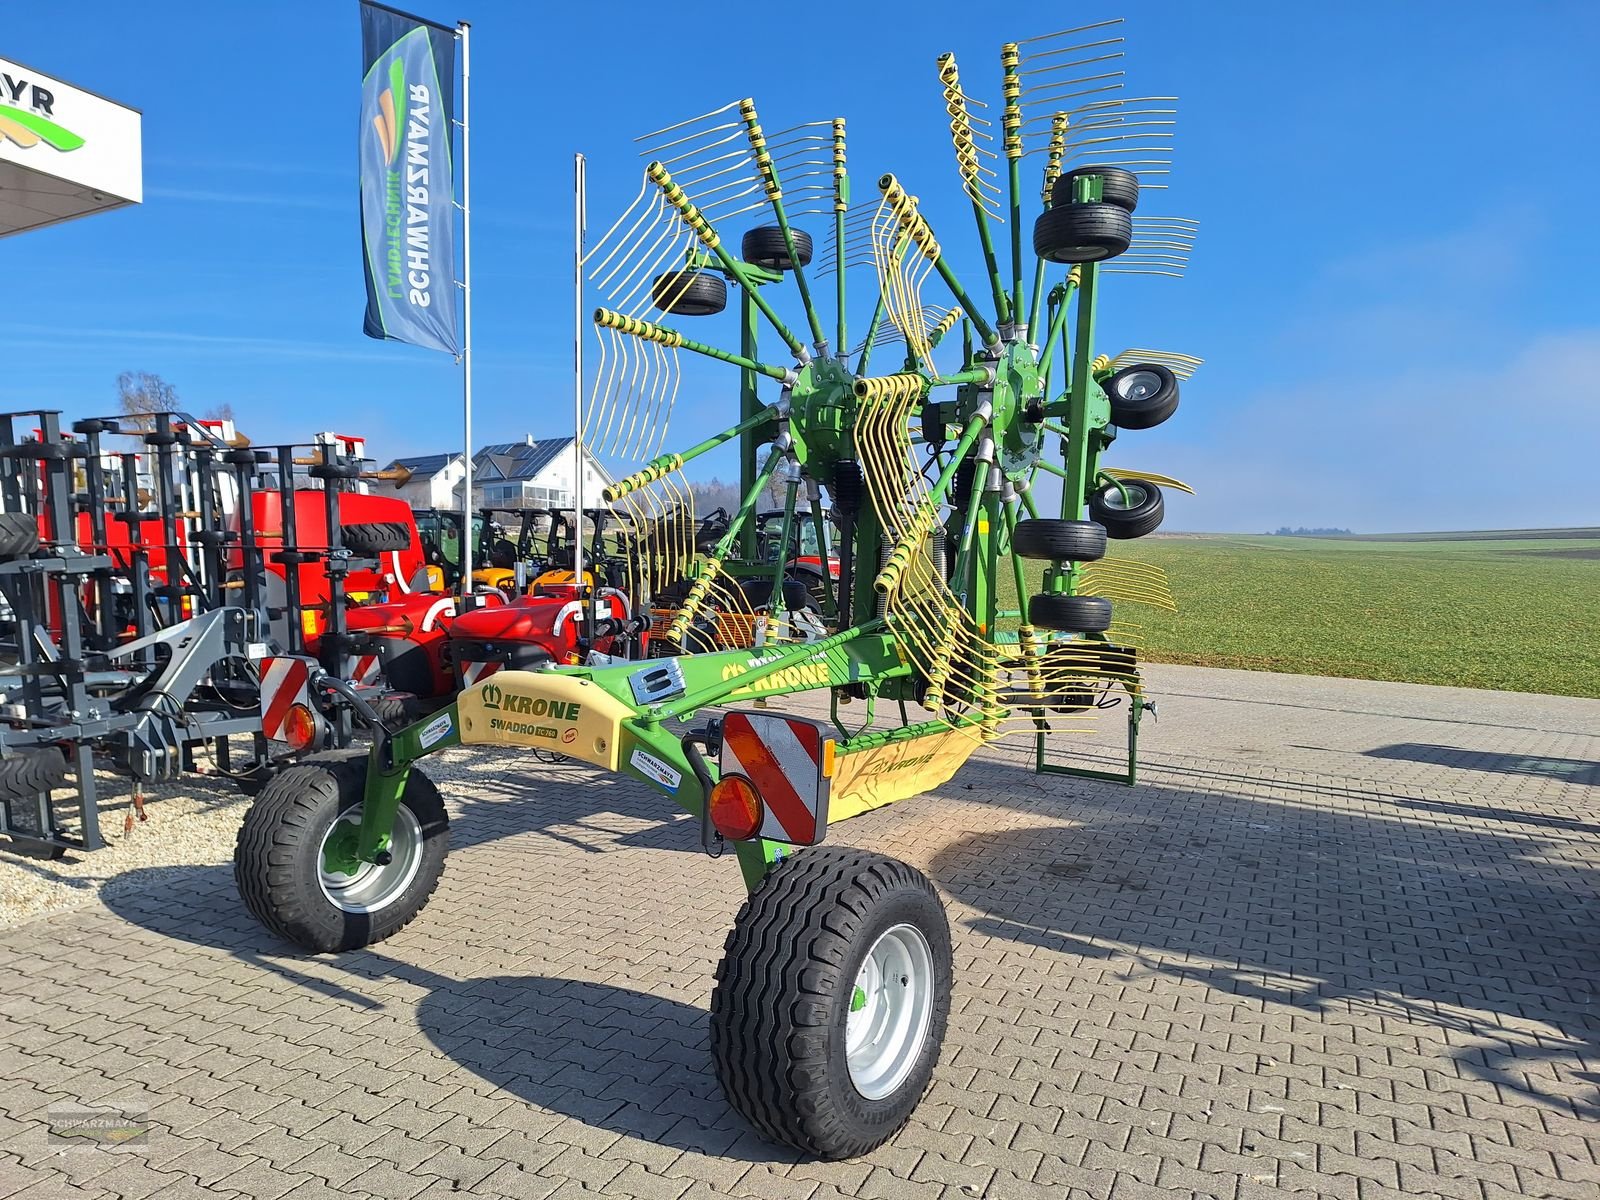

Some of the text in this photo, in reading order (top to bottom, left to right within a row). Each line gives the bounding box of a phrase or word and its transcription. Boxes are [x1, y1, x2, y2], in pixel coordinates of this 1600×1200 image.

[0, 73, 54, 116] YR
[503, 694, 582, 721] KRONE
[490, 718, 535, 736] SWADRO
[637, 751, 674, 780] SCHWARZMAYR
